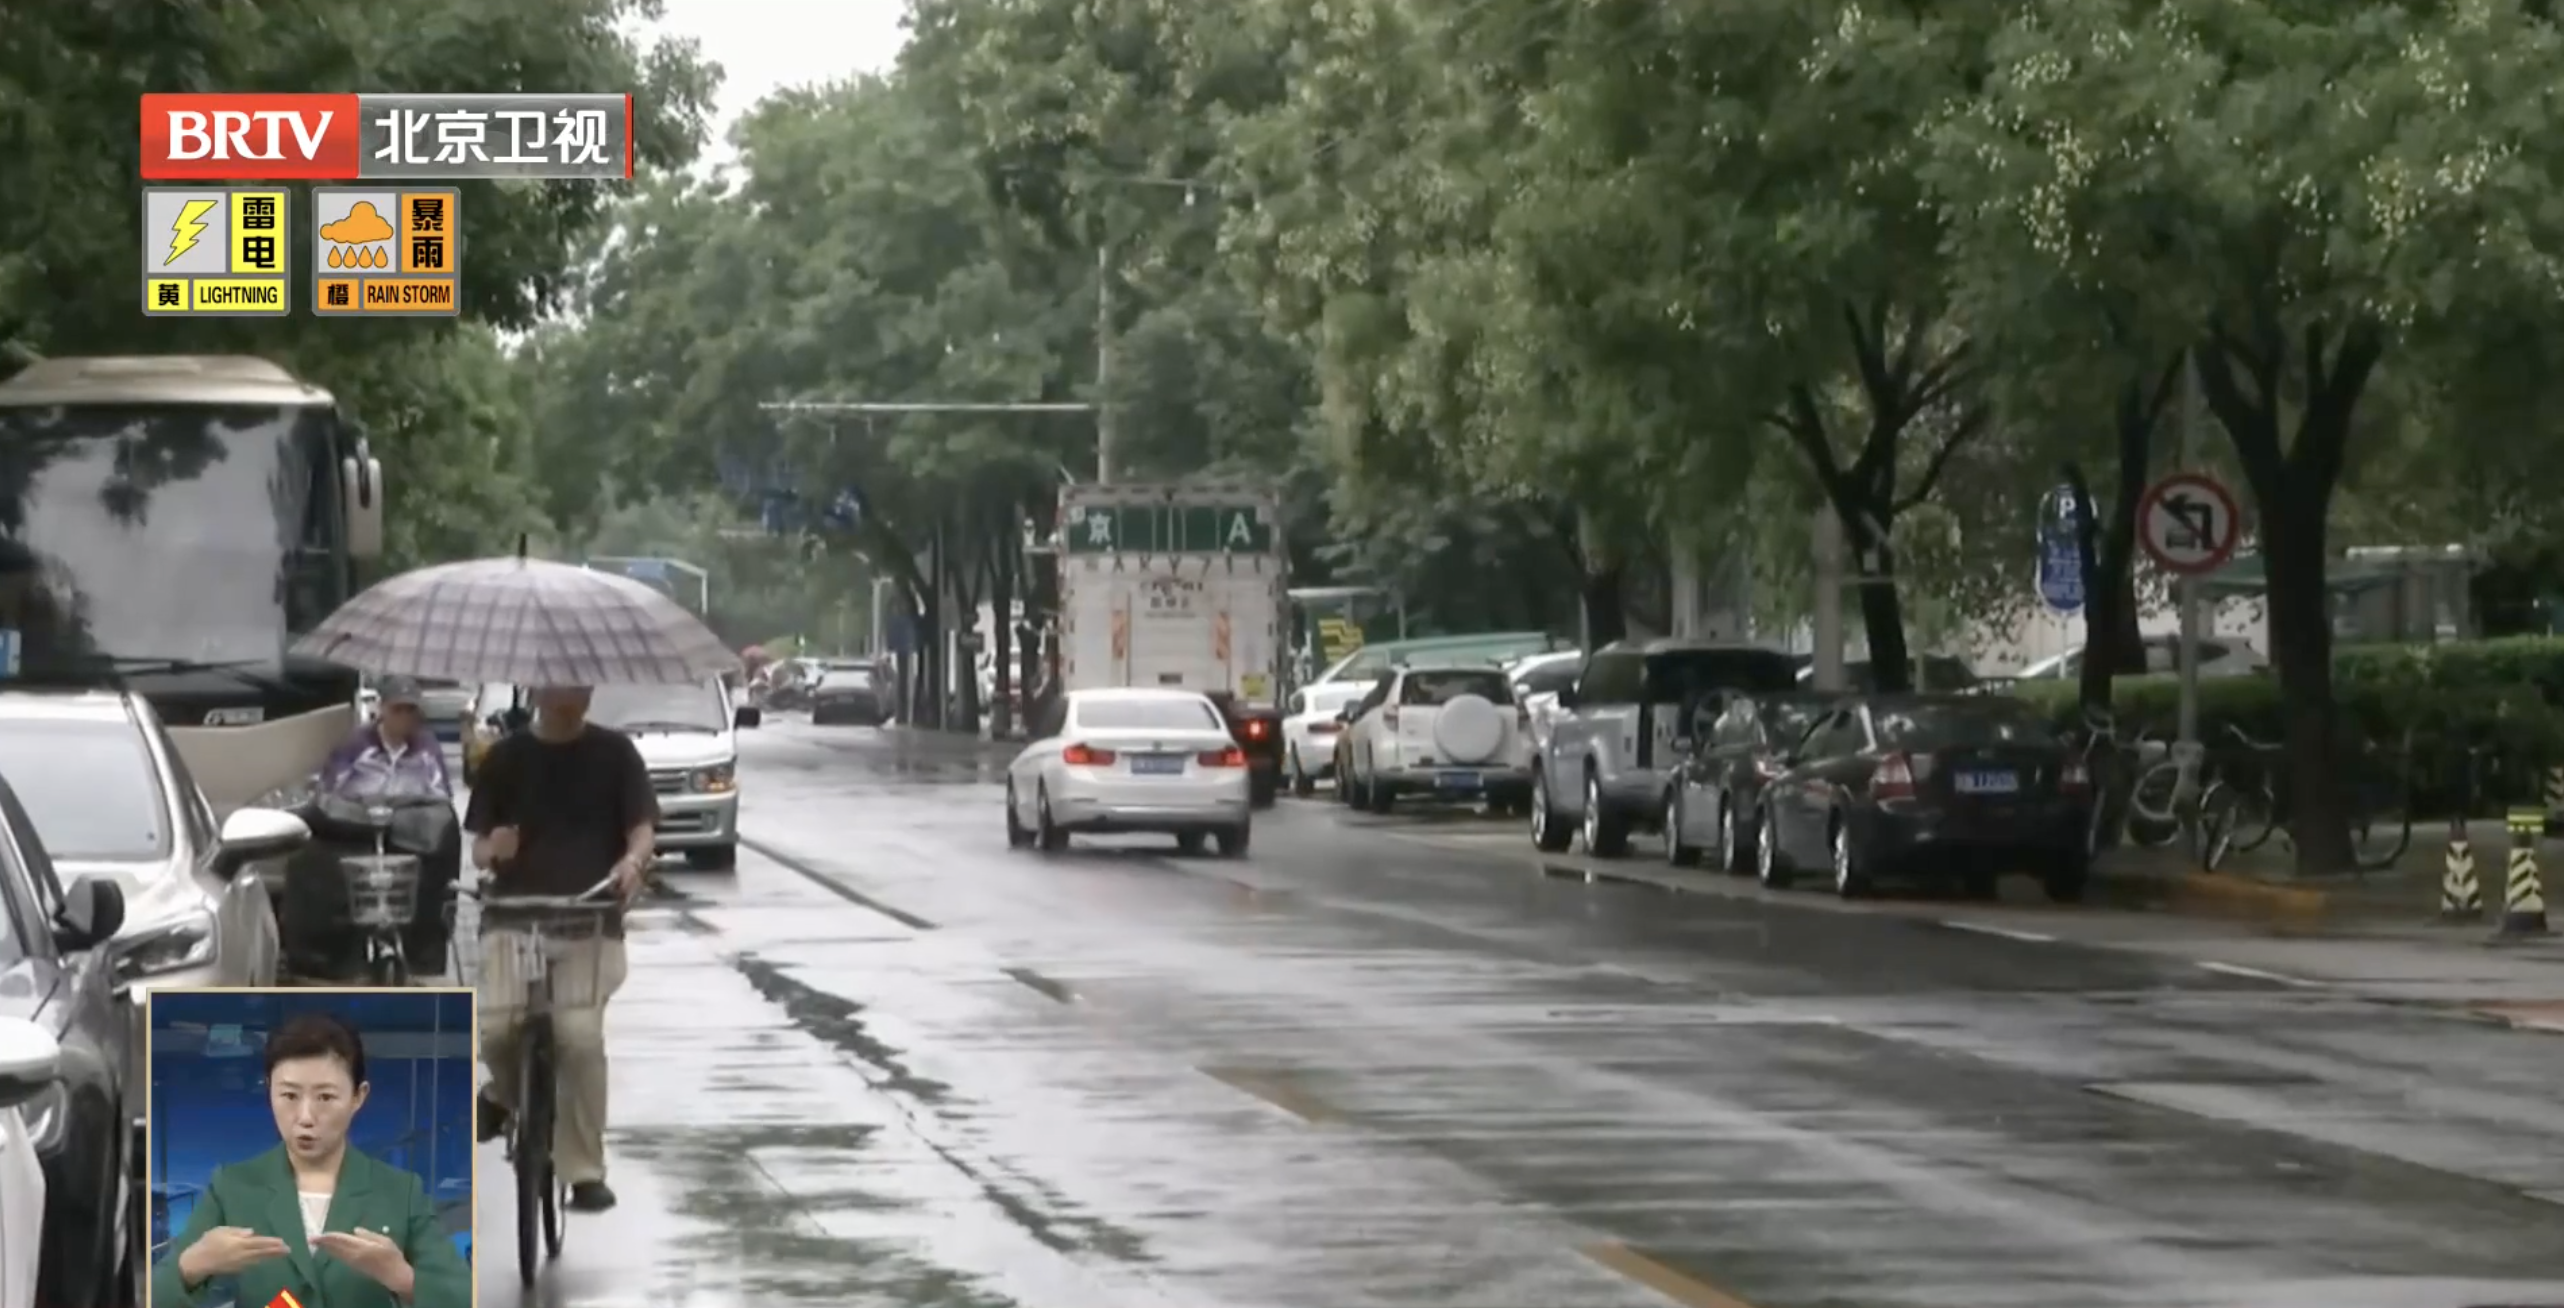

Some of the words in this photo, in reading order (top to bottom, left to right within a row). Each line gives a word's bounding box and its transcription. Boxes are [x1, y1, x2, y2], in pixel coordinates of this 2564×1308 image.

[2059, 496, 2076, 519] P
[1088, 512, 1111, 544] 京
[1229, 512, 1251, 544] A
